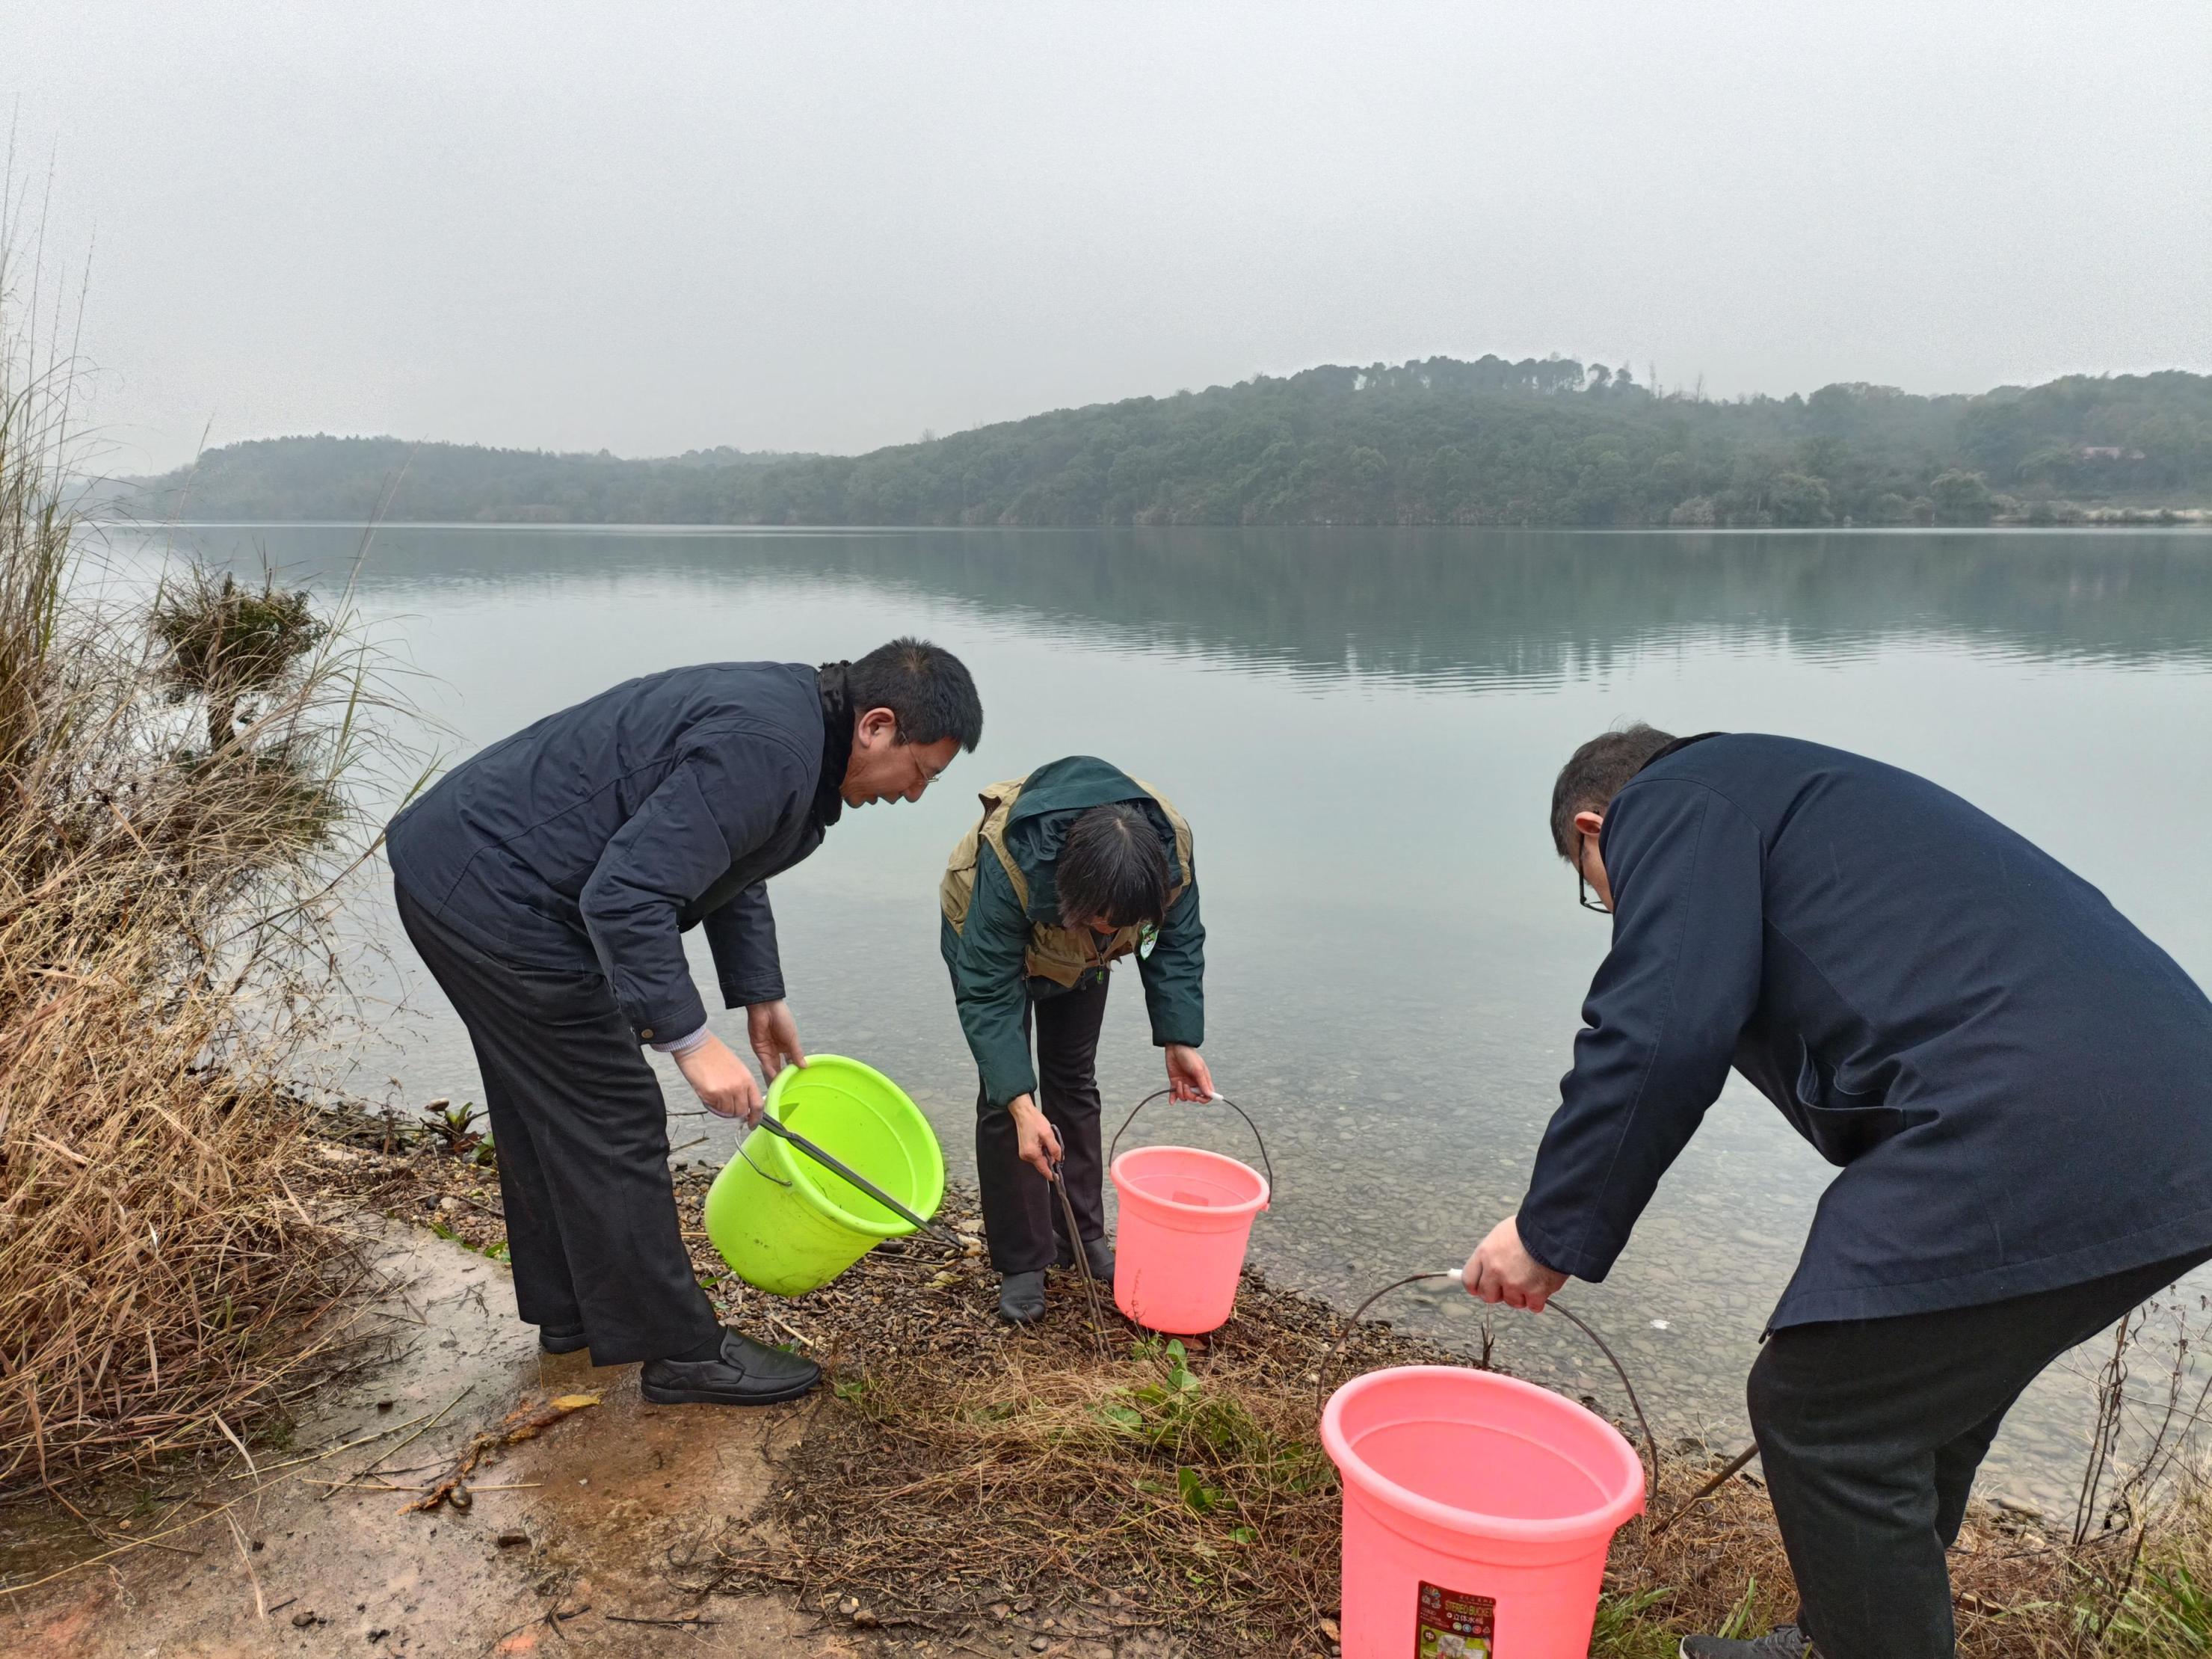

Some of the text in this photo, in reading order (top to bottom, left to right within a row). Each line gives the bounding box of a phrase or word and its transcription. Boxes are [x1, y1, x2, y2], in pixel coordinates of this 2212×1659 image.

[1445, 1601, 1468, 1614] STEREO
[1469, 1605, 1492, 1617] BUCKET
[1426, 1631, 1435, 1640] 中
